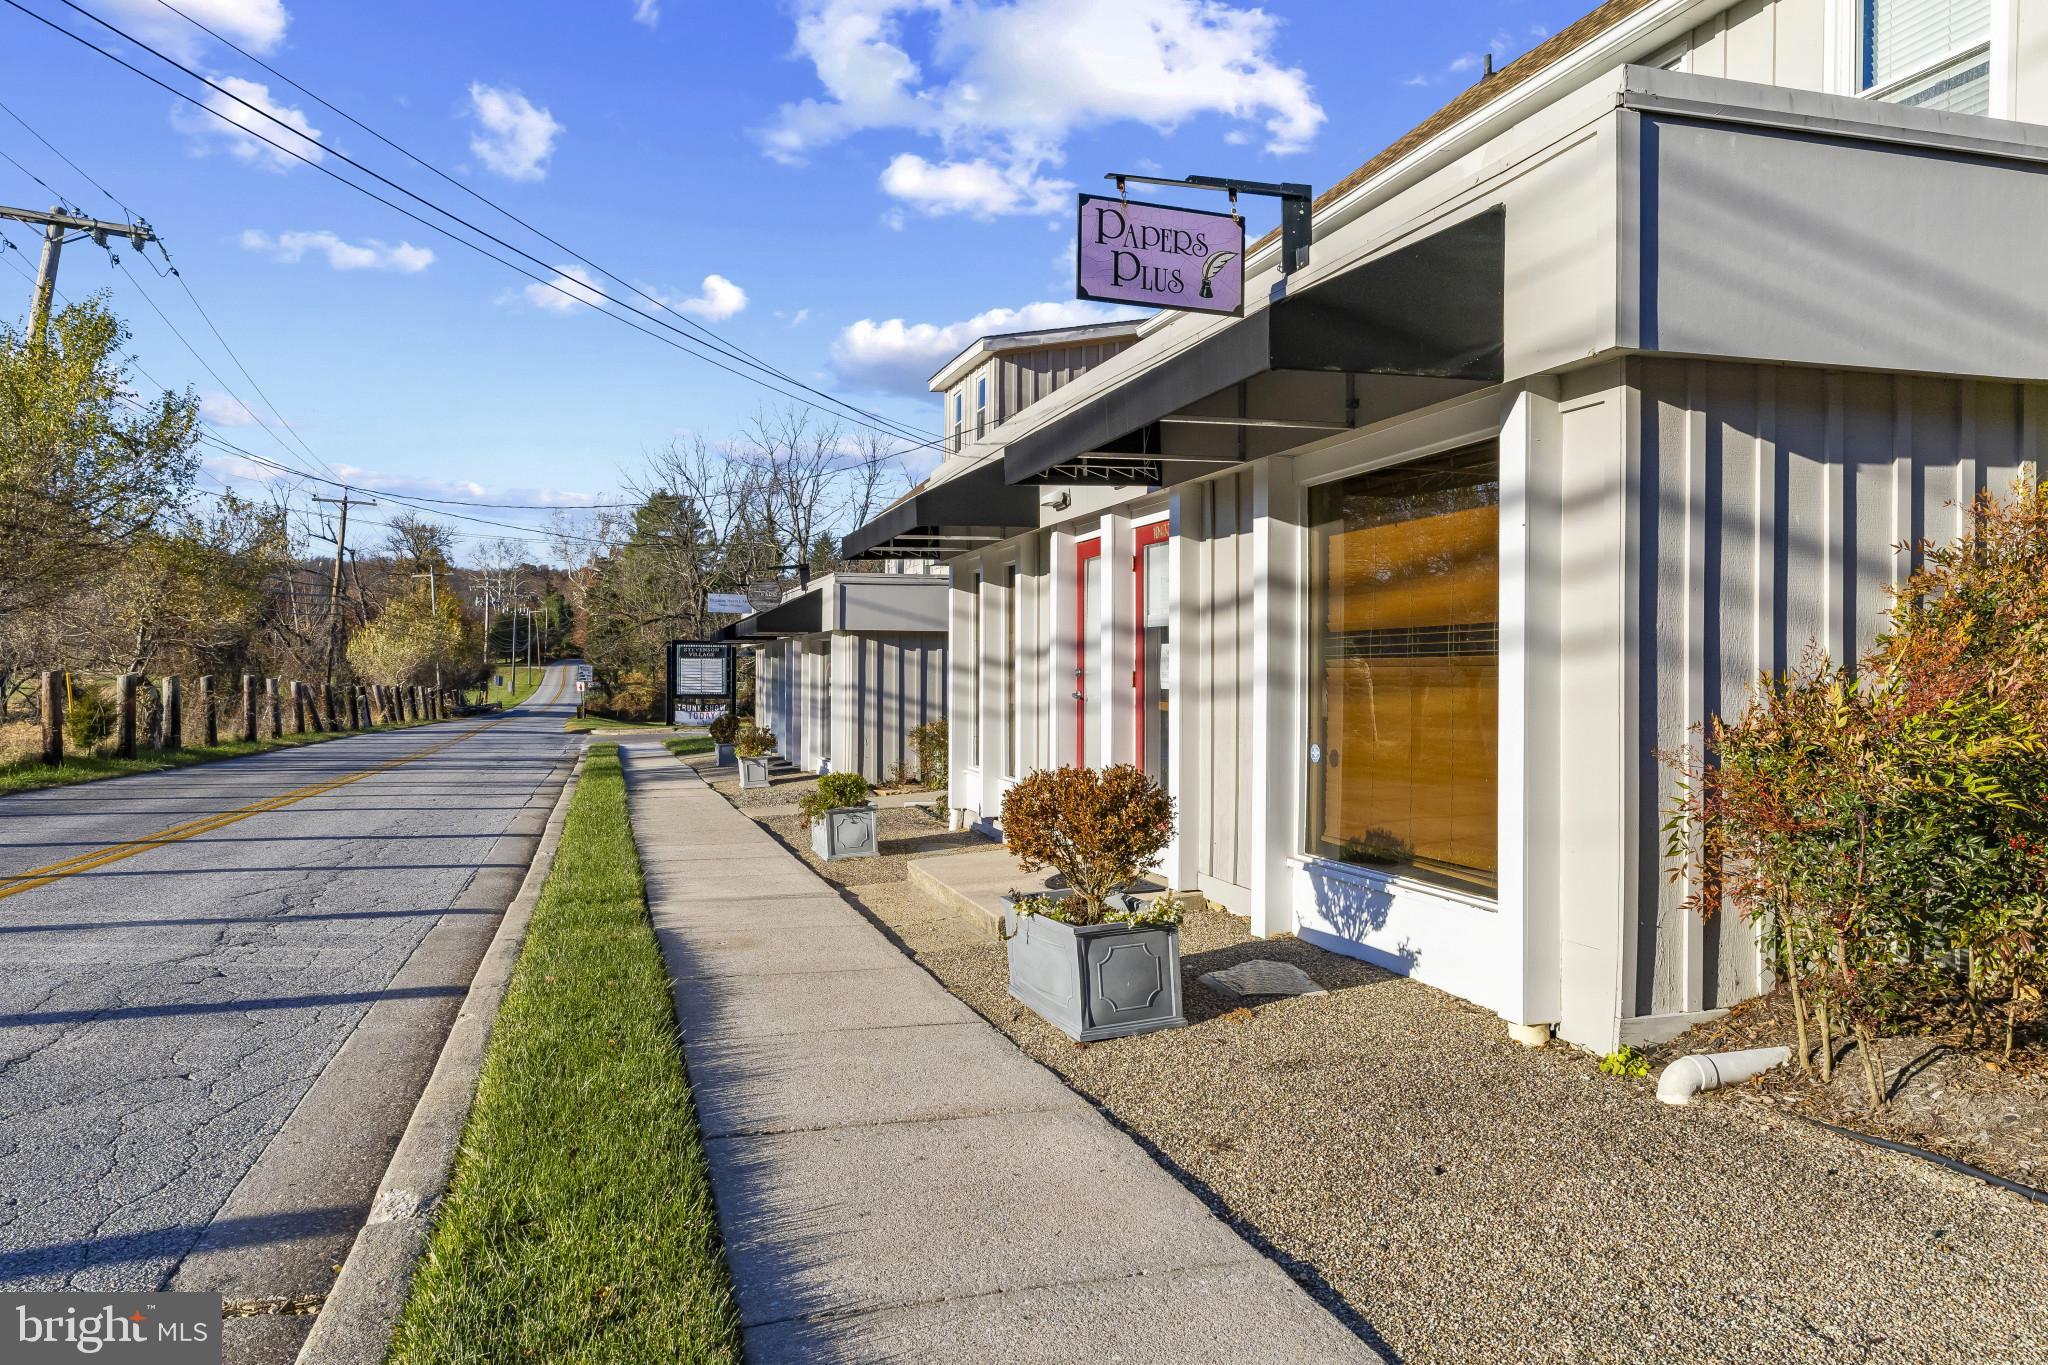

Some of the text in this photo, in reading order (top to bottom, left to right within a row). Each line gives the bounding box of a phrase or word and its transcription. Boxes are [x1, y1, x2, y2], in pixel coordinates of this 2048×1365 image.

[1094, 207, 1209, 257] PAPERS
[1110, 250, 1184, 294] PLUS
[677, 703, 702, 711] TRUNK
[689, 712, 715, 720] TODAY
